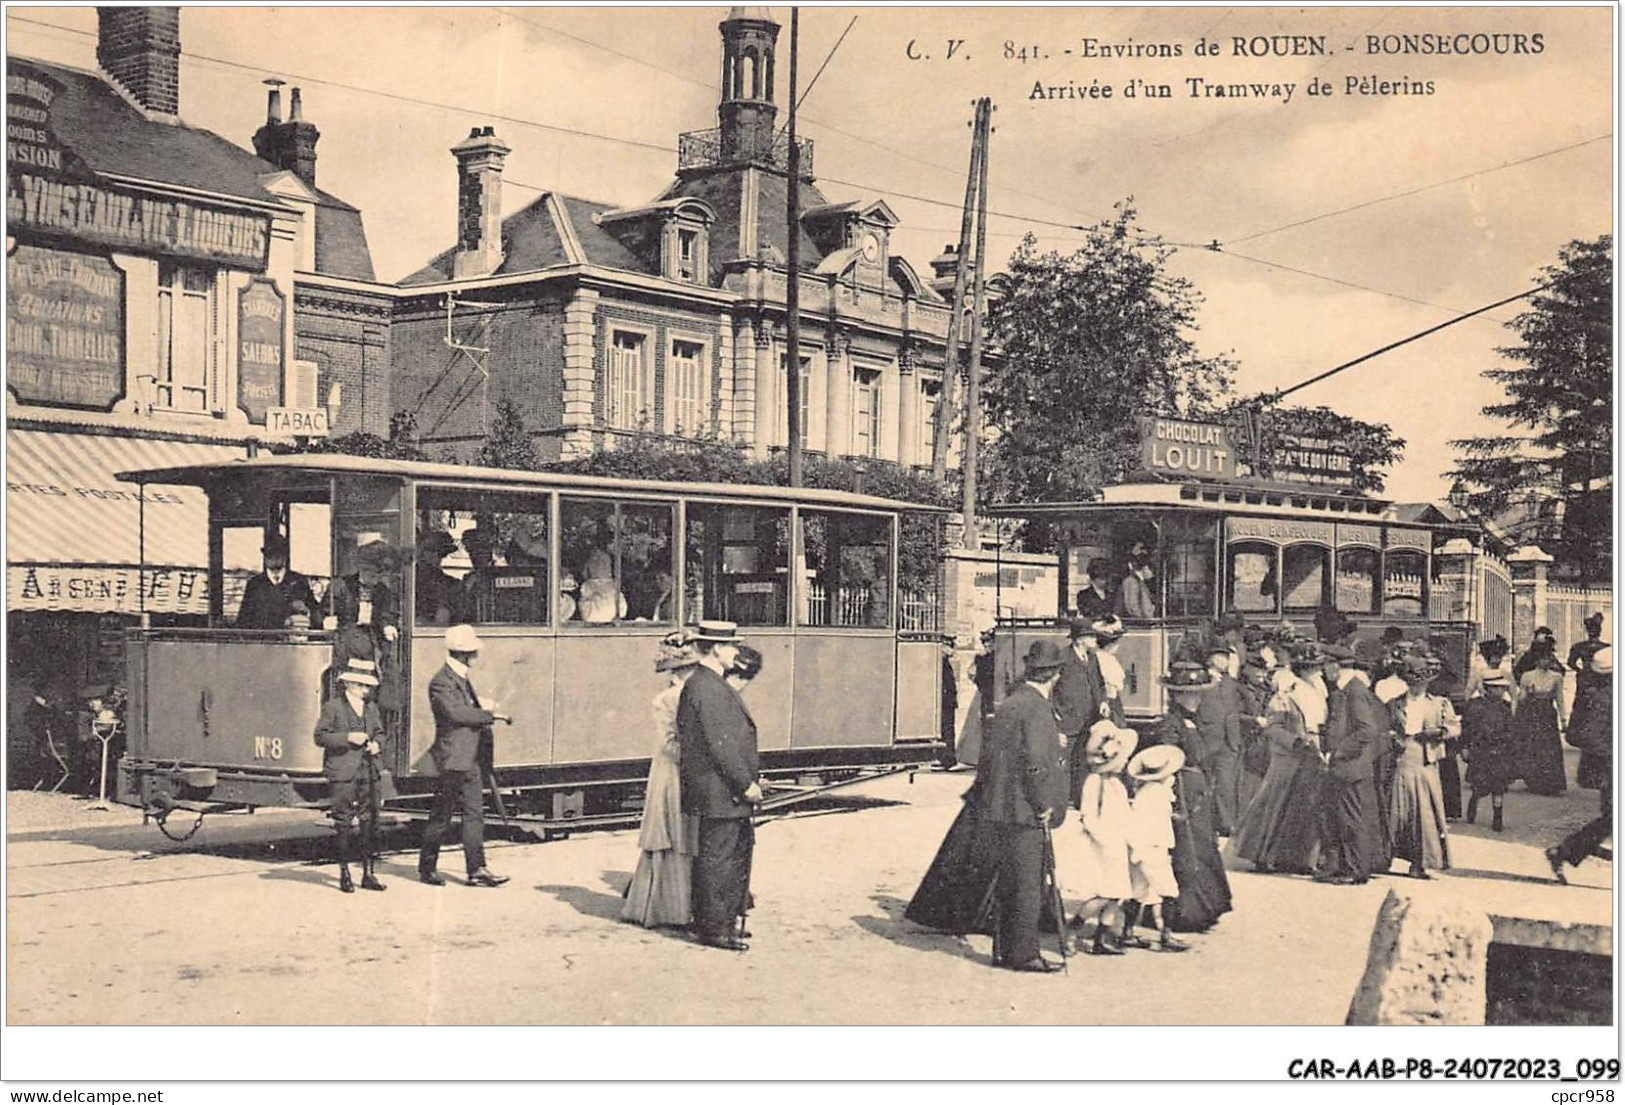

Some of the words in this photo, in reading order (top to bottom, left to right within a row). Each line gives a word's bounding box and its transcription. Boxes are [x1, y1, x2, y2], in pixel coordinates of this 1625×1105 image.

[272, 412, 323, 430] TABAC
[1157, 421, 1222, 446] CHOCOLAT
[1152, 443, 1227, 475] LOUIT
